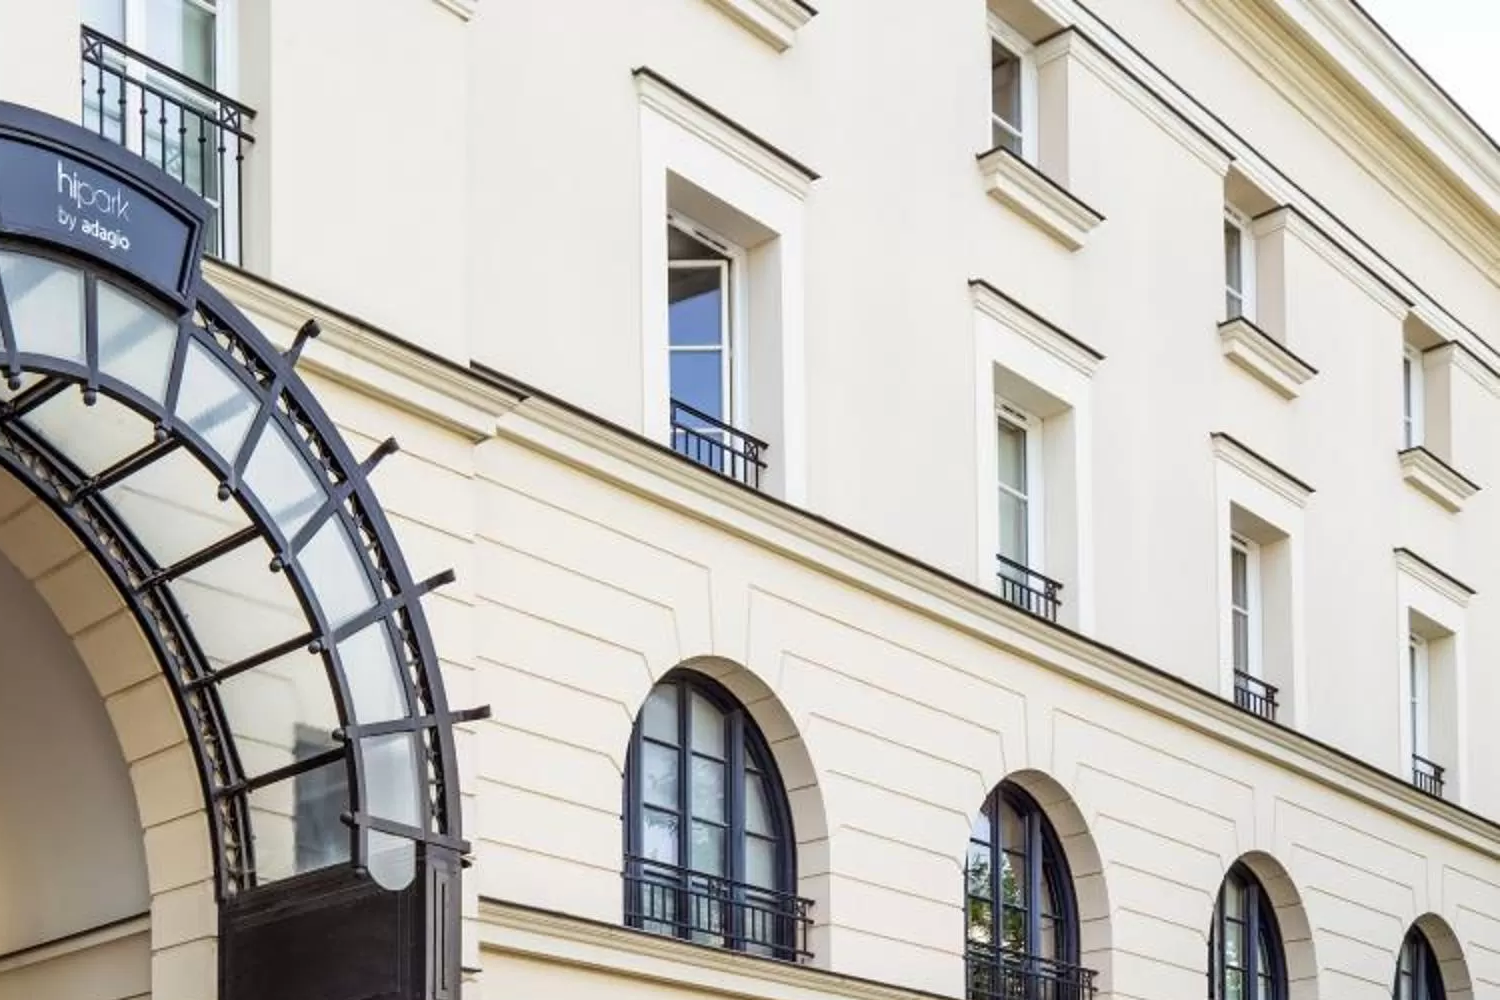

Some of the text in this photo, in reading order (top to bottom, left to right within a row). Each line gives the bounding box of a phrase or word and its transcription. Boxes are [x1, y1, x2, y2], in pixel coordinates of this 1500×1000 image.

[56, 159, 130, 221] hipark
[57, 206, 131, 250] by adagio
